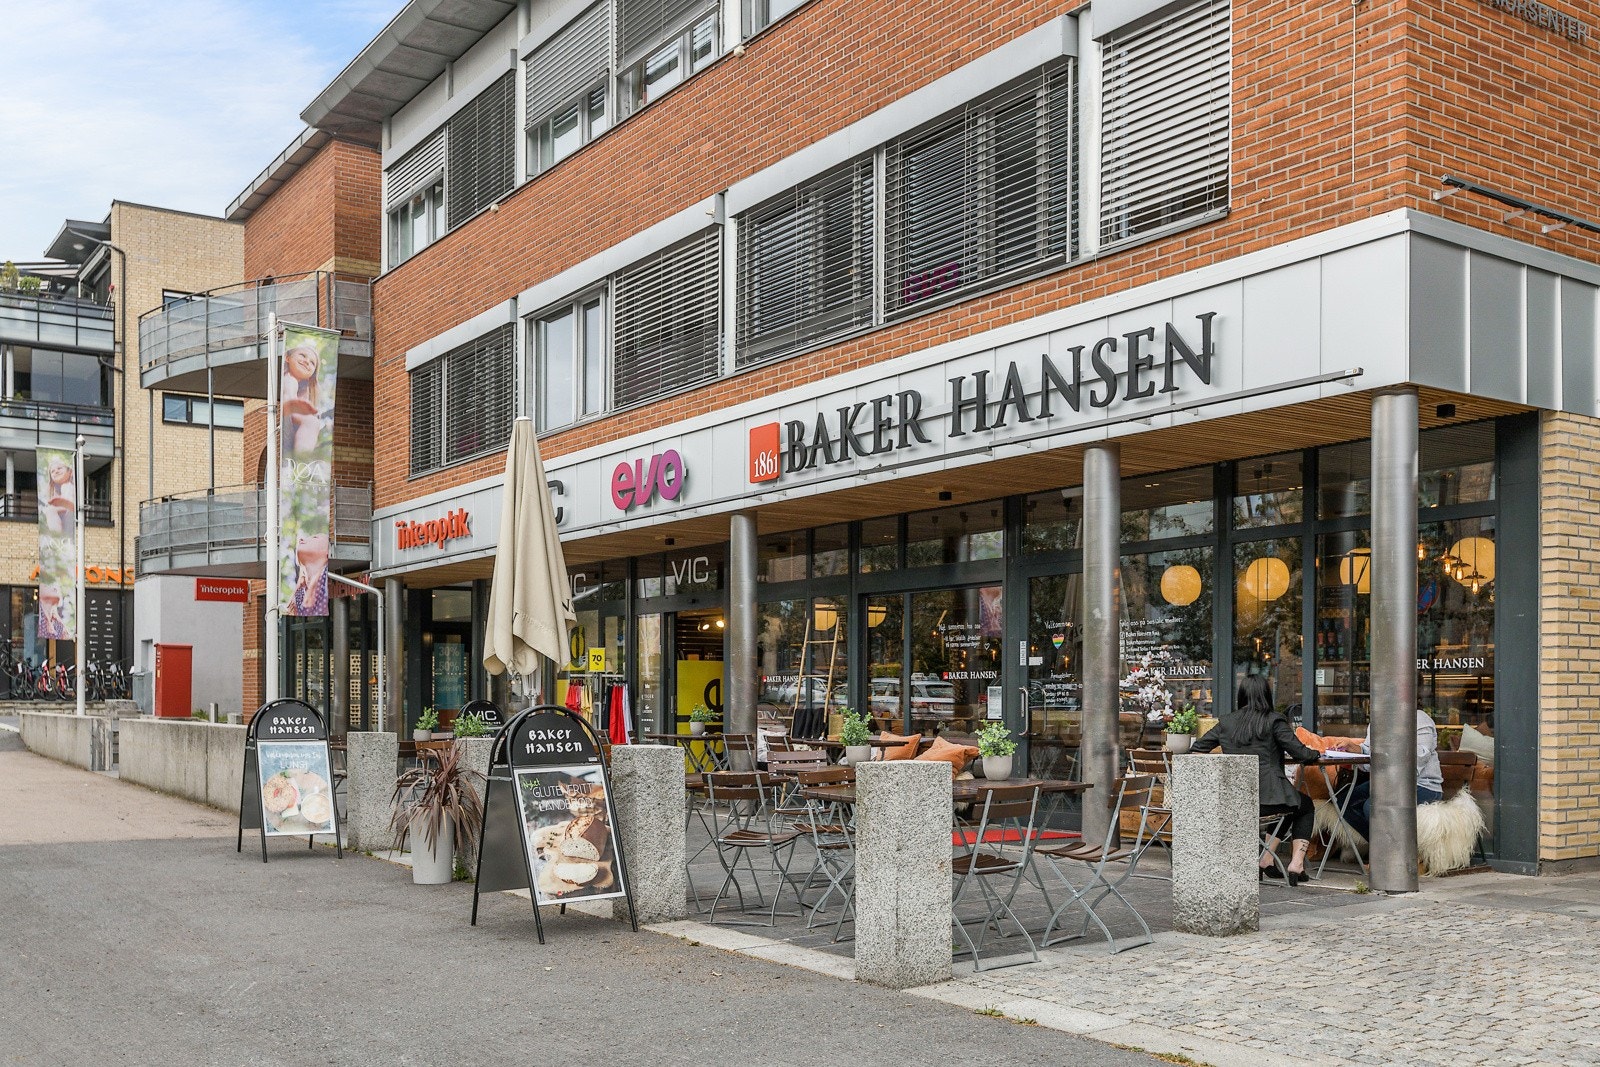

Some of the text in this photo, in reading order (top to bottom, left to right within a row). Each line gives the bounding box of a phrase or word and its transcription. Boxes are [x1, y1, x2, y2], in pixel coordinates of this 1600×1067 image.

[785, 312, 1218, 473] BAKER HANSEN
[754, 450, 778, 477] 1861
[611, 449, 683, 510] evo
[671, 556, 709, 586] VIC
[592, 654, 602, 662] 70
[1433, 657, 1485, 669] HANSEN
[948, 671, 969, 680] BAKER
[970, 670, 998, 679] HANSEN
[1169, 665, 1206, 676] HANSEN
[766, 675, 782, 683] BAKER
